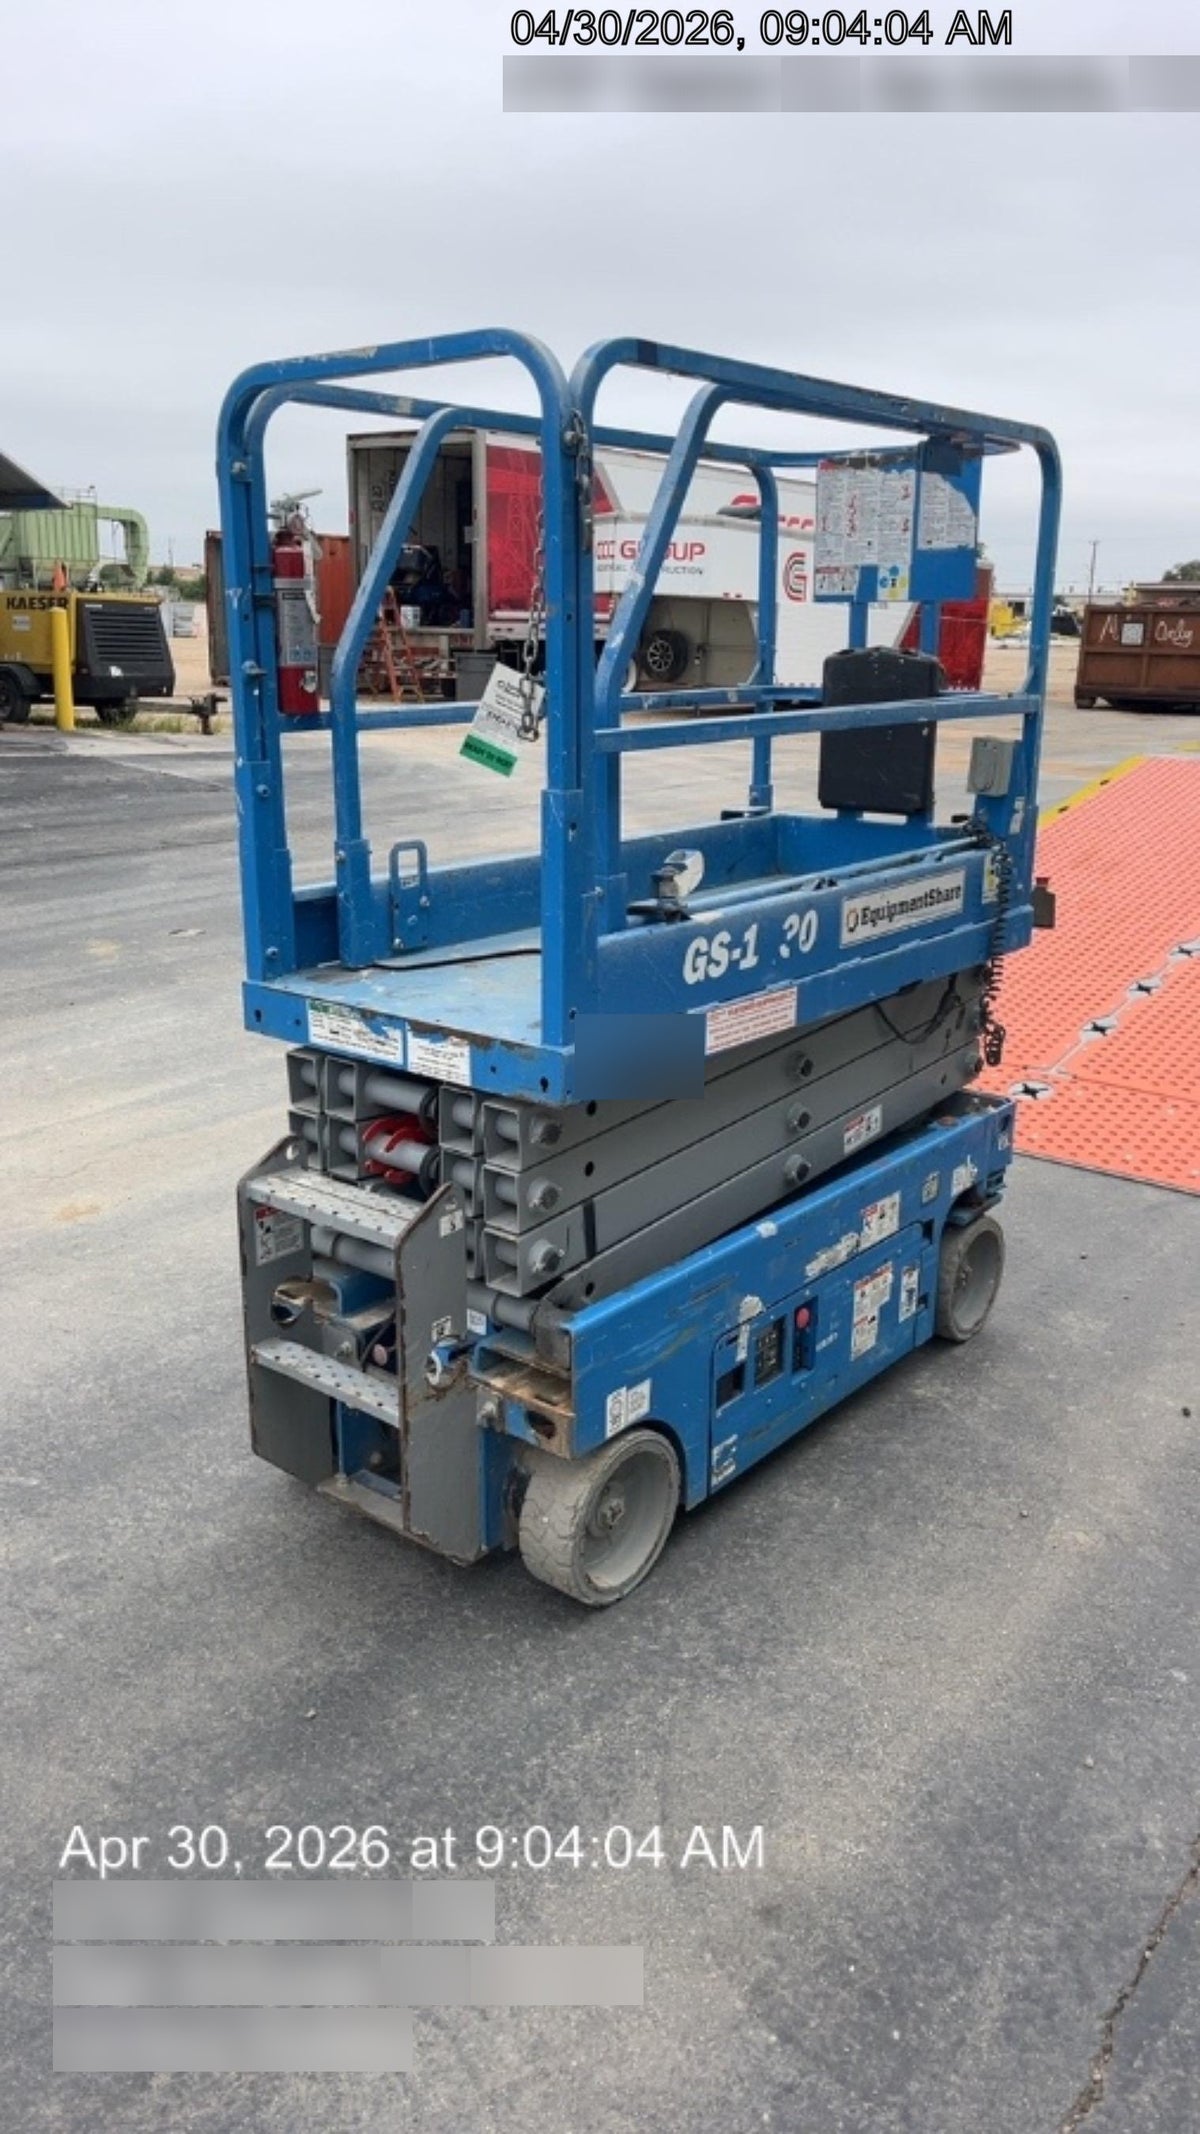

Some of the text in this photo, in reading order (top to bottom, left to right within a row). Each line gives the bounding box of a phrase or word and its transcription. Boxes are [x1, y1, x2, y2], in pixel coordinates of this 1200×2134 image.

[621, 540, 705, 562] GUP
[7, 596, 70, 611] KAESER
[860, 883, 962, 928] EquipmentShare
